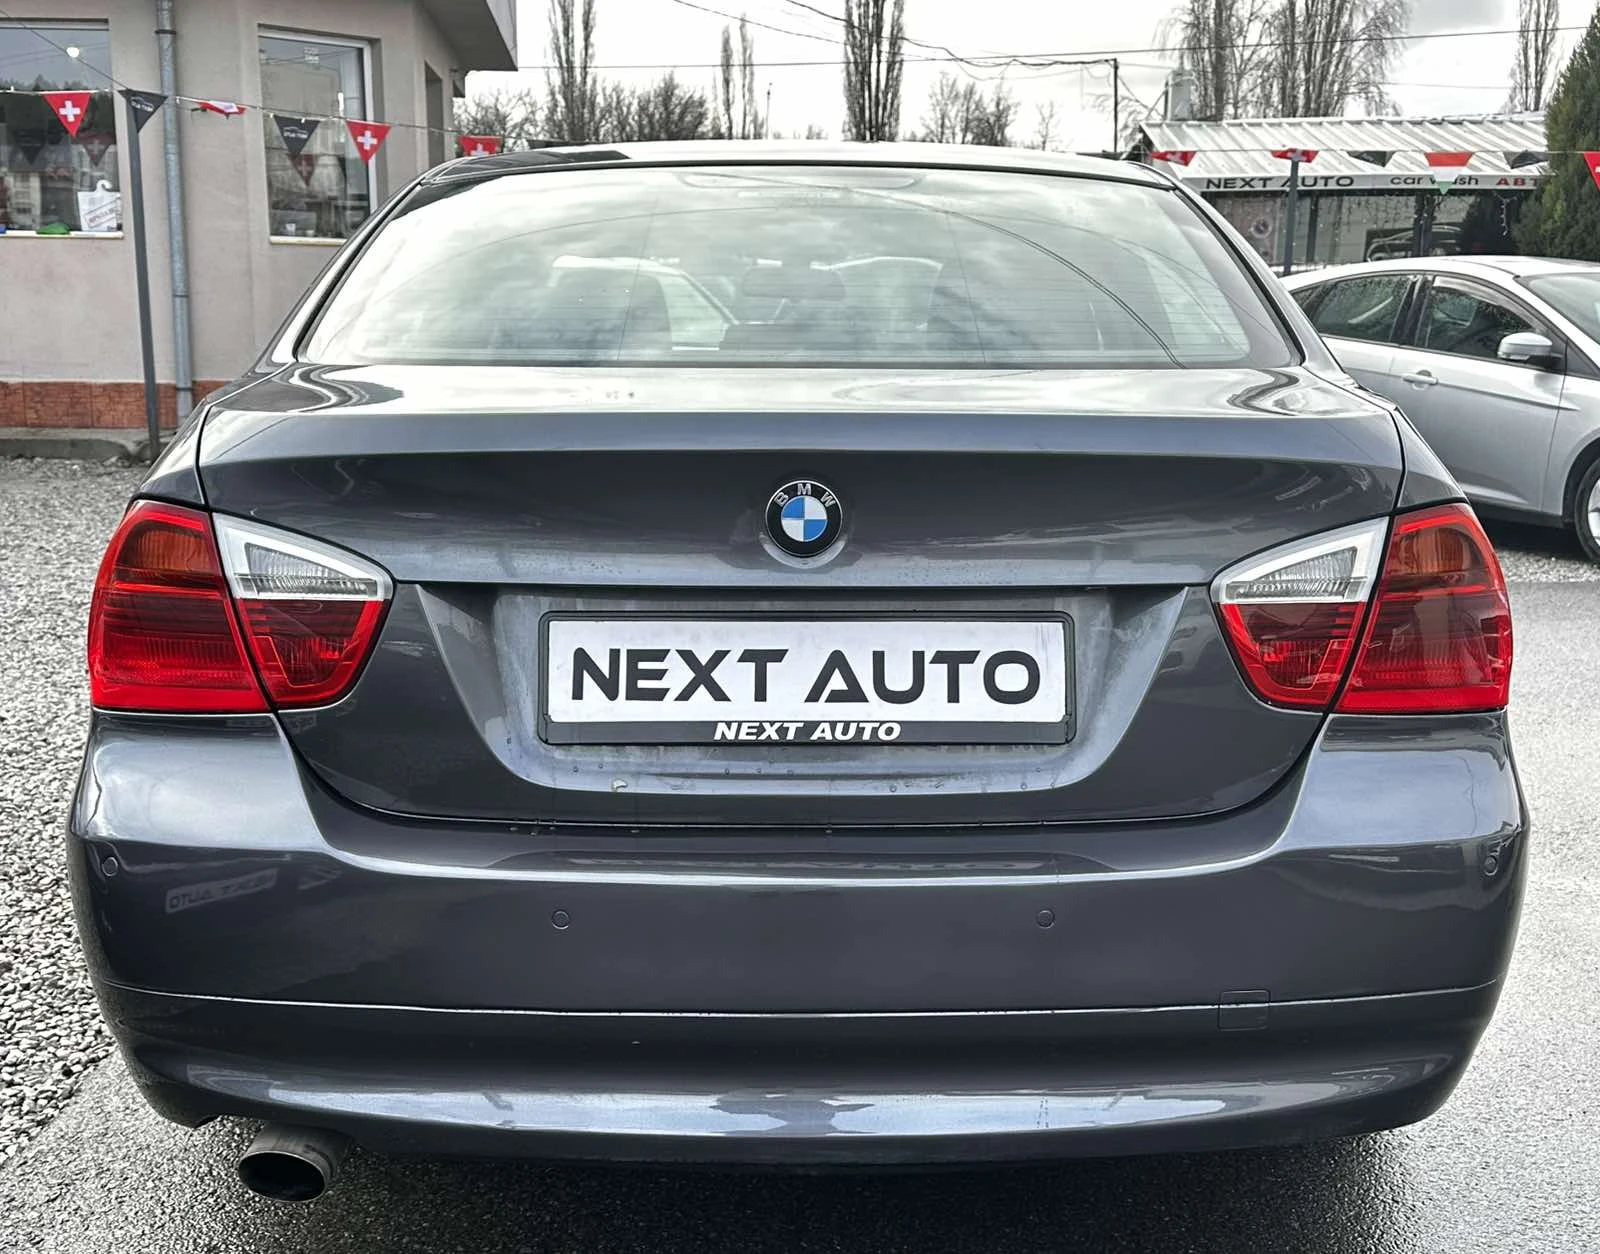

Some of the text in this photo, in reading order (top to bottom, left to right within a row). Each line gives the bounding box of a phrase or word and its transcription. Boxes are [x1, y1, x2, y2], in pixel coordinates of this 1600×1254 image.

[1206, 177, 1273, 189] NEXT
[1390, 175, 1479, 186] car wsh
[773, 483, 836, 508] BMW
[572, 647, 1041, 705] NEXT AUTO
[713, 722, 901, 741] NEXT AUTO
